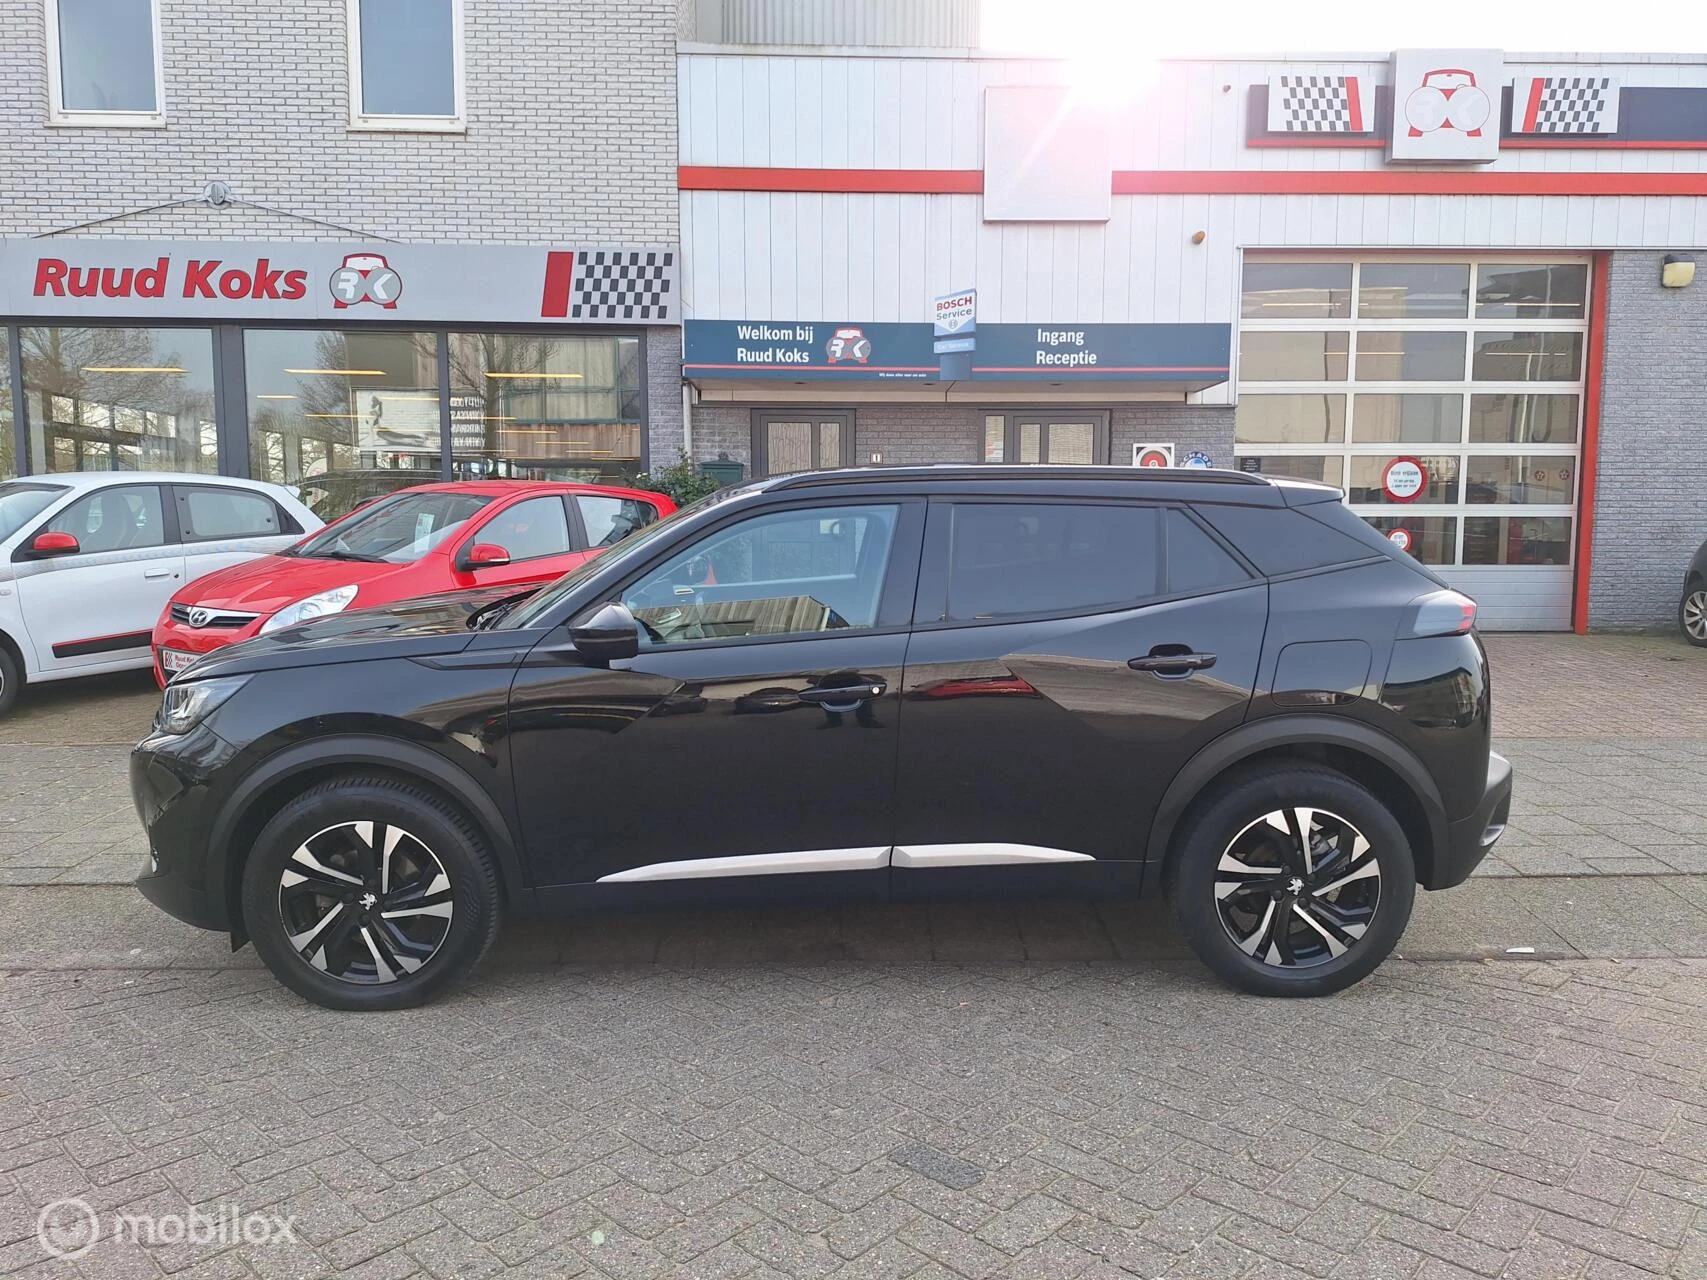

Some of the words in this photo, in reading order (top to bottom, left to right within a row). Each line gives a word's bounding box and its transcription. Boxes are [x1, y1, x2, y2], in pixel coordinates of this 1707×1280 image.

[33, 257, 170, 298] Ruud
[182, 258, 308, 300] Koks
[936, 296, 973, 311] BOSCH
[936, 308, 973, 321] Service
[737, 325, 793, 340] Welkom
[796, 325, 814, 344] bij
[1037, 328, 1085, 346] Ingang
[737, 347, 773, 362] Ruud
[776, 347, 810, 363] Koks
[1036, 350, 1097, 367] Receptie
